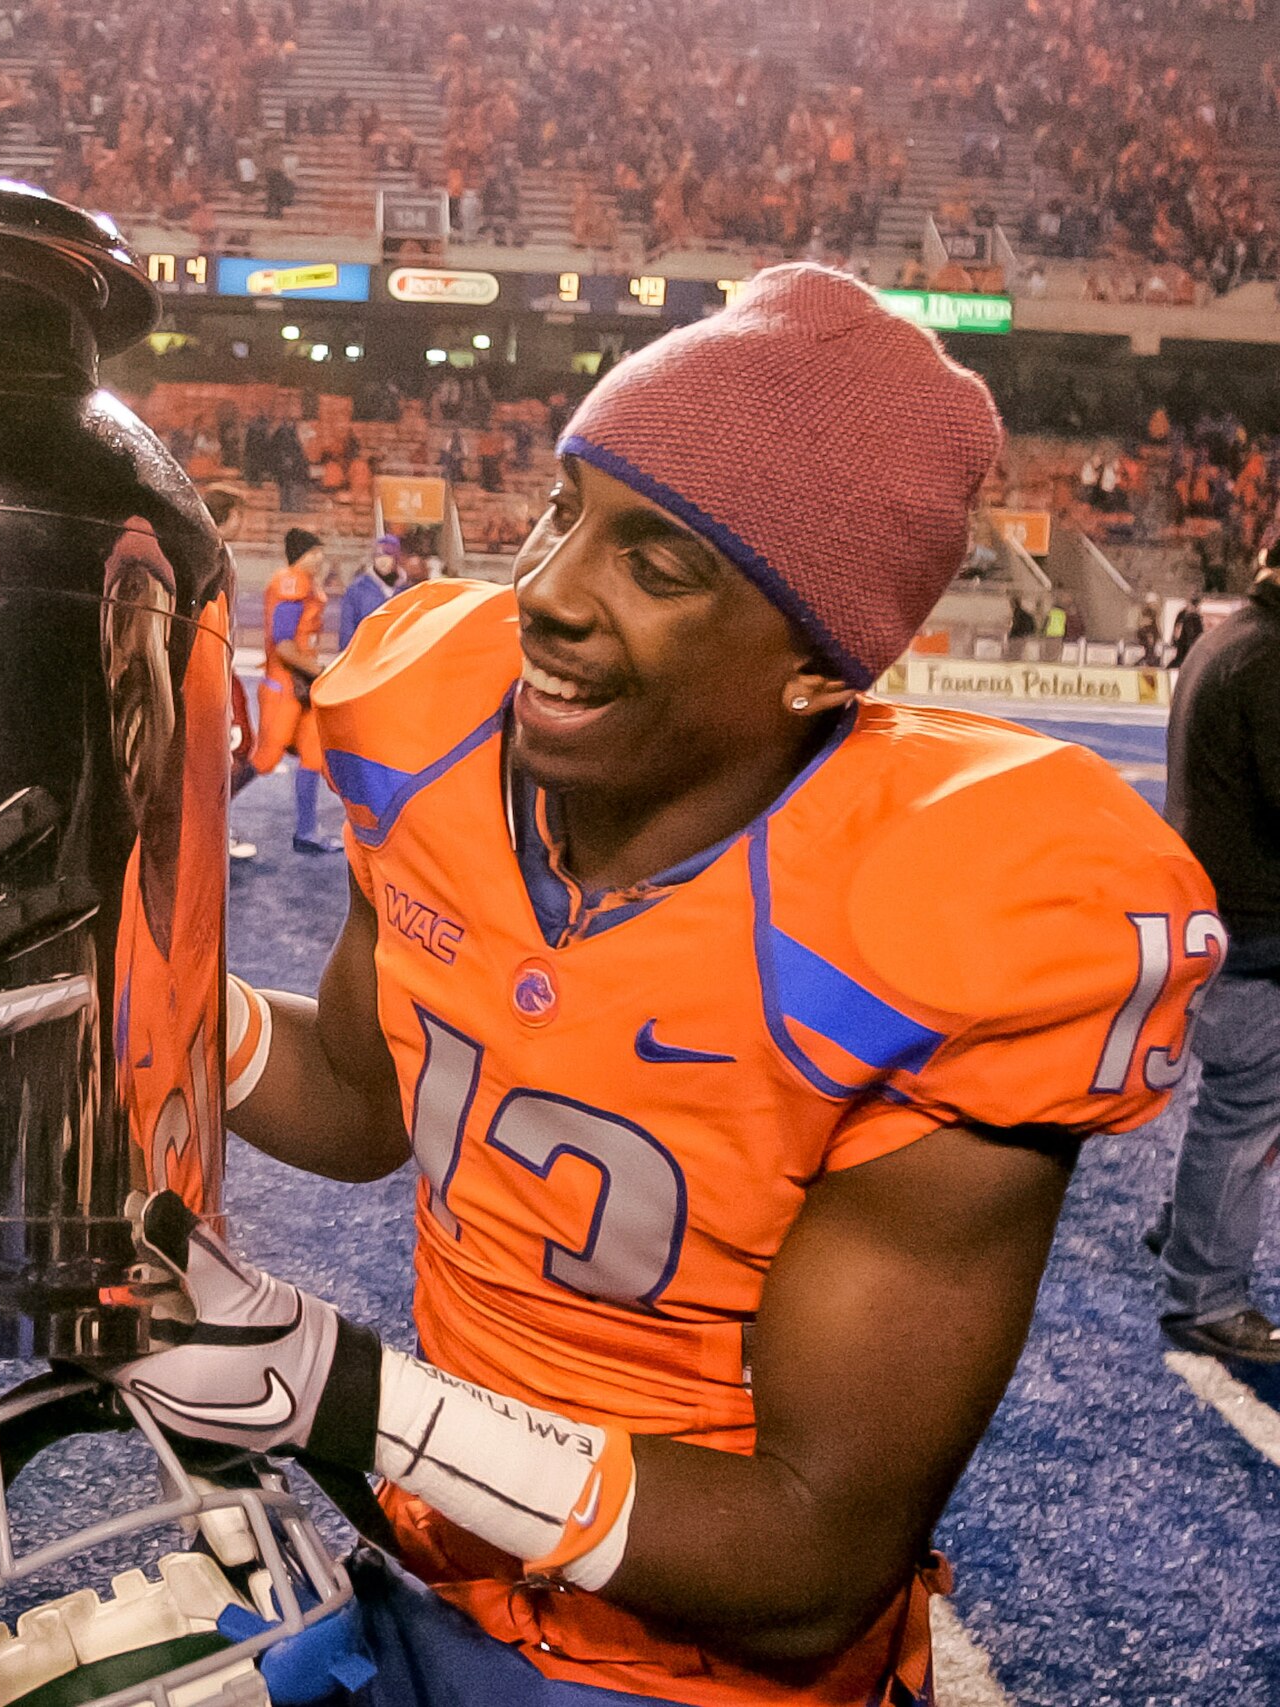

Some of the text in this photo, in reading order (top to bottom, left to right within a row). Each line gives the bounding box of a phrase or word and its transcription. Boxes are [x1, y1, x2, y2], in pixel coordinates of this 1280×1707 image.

[559, 272, 579, 301] 9
[928, 664, 1123, 698] Famous Potatoes
[385, 883, 465, 967] WAC
[1087, 909, 1231, 1095] 13
[410, 998, 688, 1309] 13
